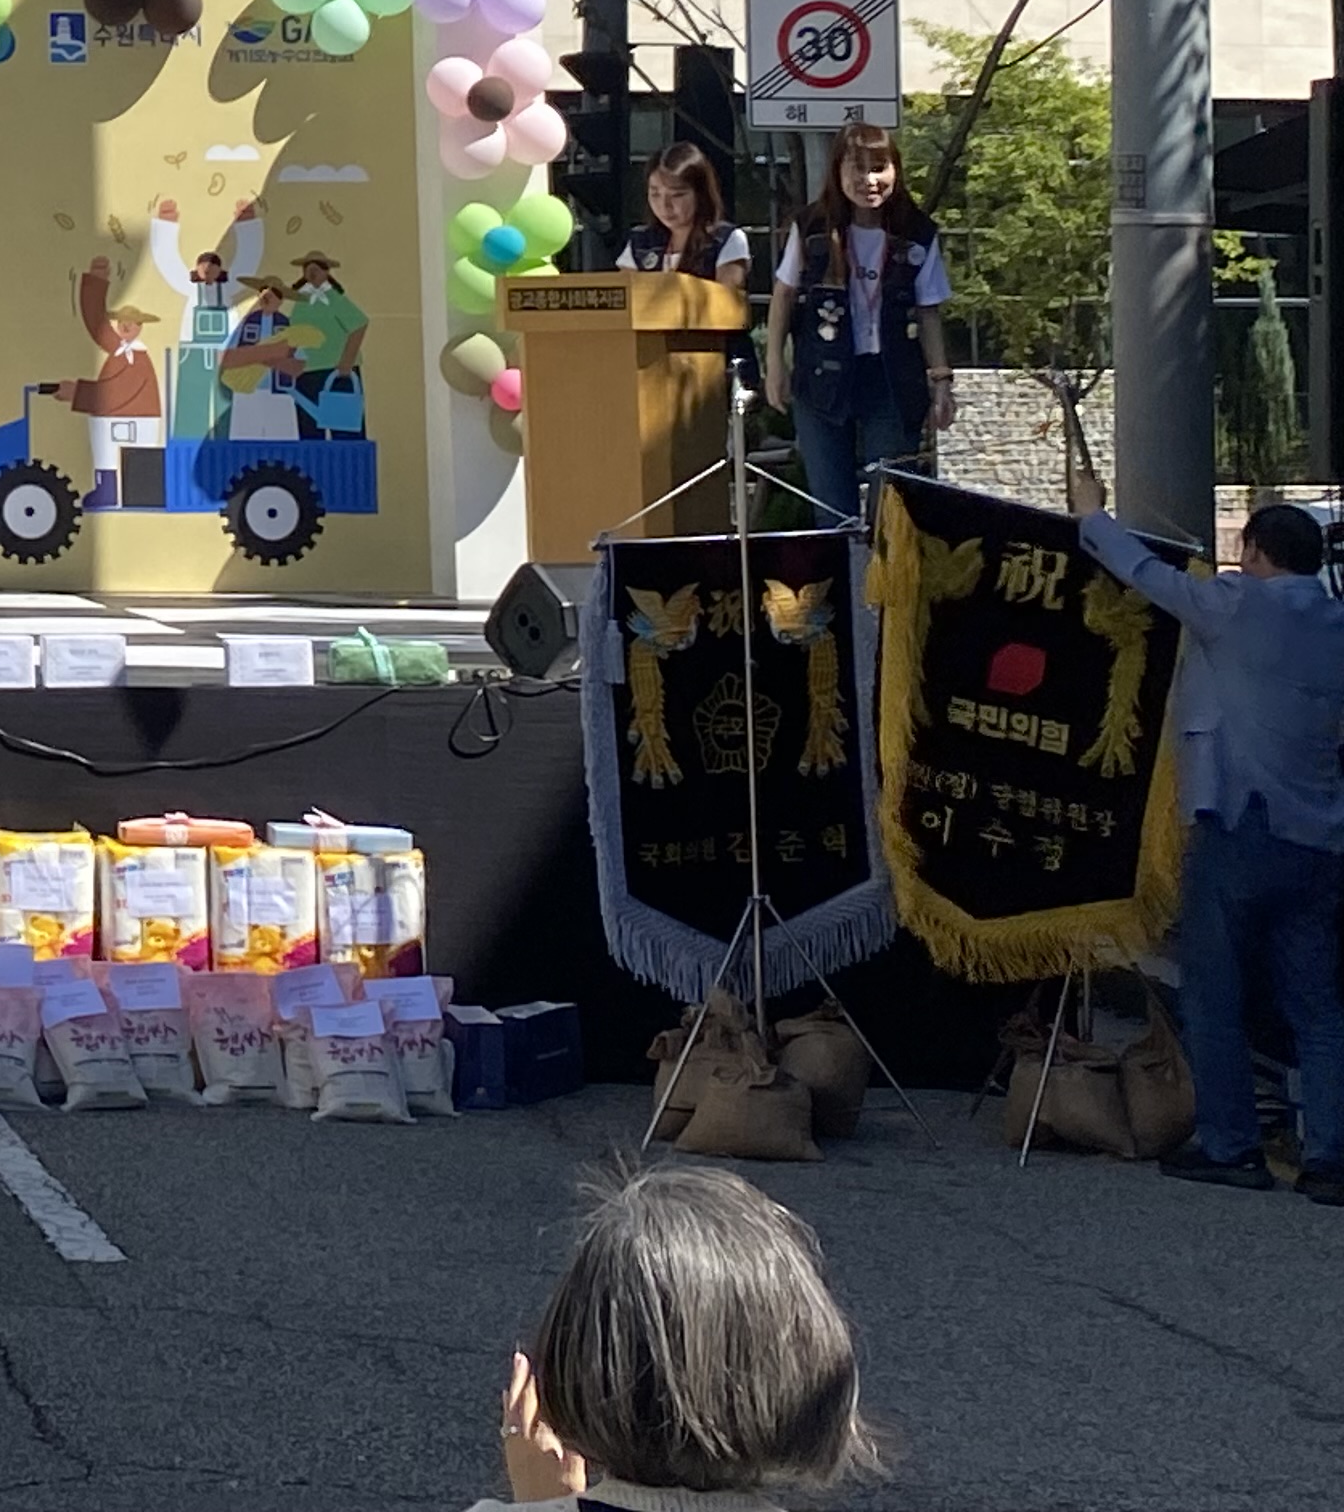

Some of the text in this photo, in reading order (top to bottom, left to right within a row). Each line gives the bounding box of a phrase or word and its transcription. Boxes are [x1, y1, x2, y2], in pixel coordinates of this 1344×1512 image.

[796, 26, 853, 62] 30
[992, 540, 1072, 613] 祝
[944, 694, 1072, 757] 국민의힘
[636, 836, 718, 869] 국회의원
[773, 829, 807, 863] 준
[920, 804, 955, 847] 이
[976, 816, 1016, 859] 수
